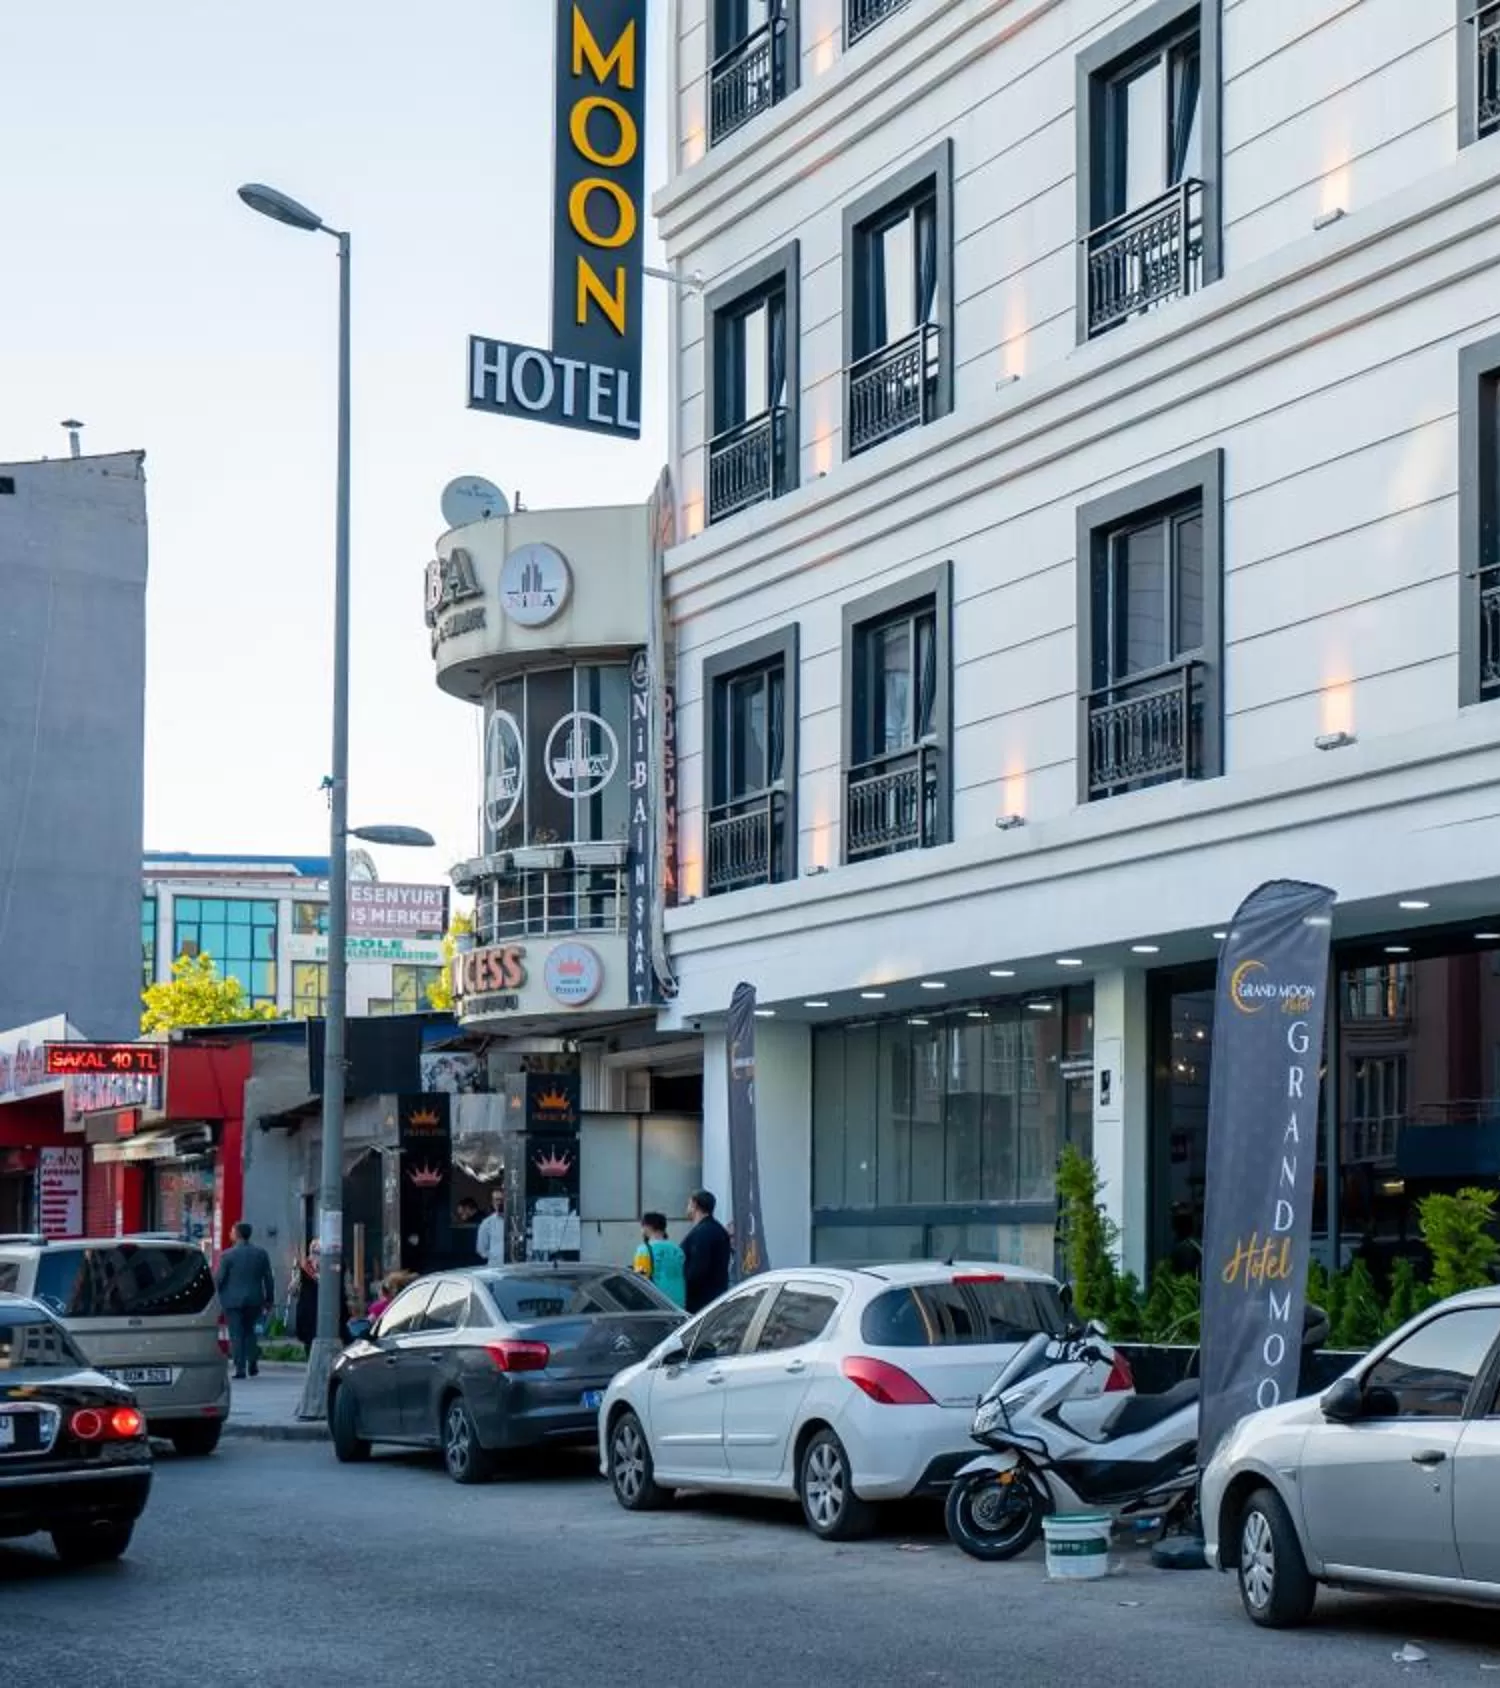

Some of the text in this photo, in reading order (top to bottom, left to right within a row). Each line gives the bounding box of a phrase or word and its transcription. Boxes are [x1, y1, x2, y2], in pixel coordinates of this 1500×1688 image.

[569, 3, 637, 336] MOON
[473, 341, 640, 429] HOTEL
[1238, 983, 1316, 1000] GRAND MOON
[53, 1051, 157, 1069] SAKAL 40 TL
[1272, 1020, 1311, 1233] GRAND
[1222, 1237, 1294, 1293] Hotel
[1256, 1287, 1291, 1409] MOO
